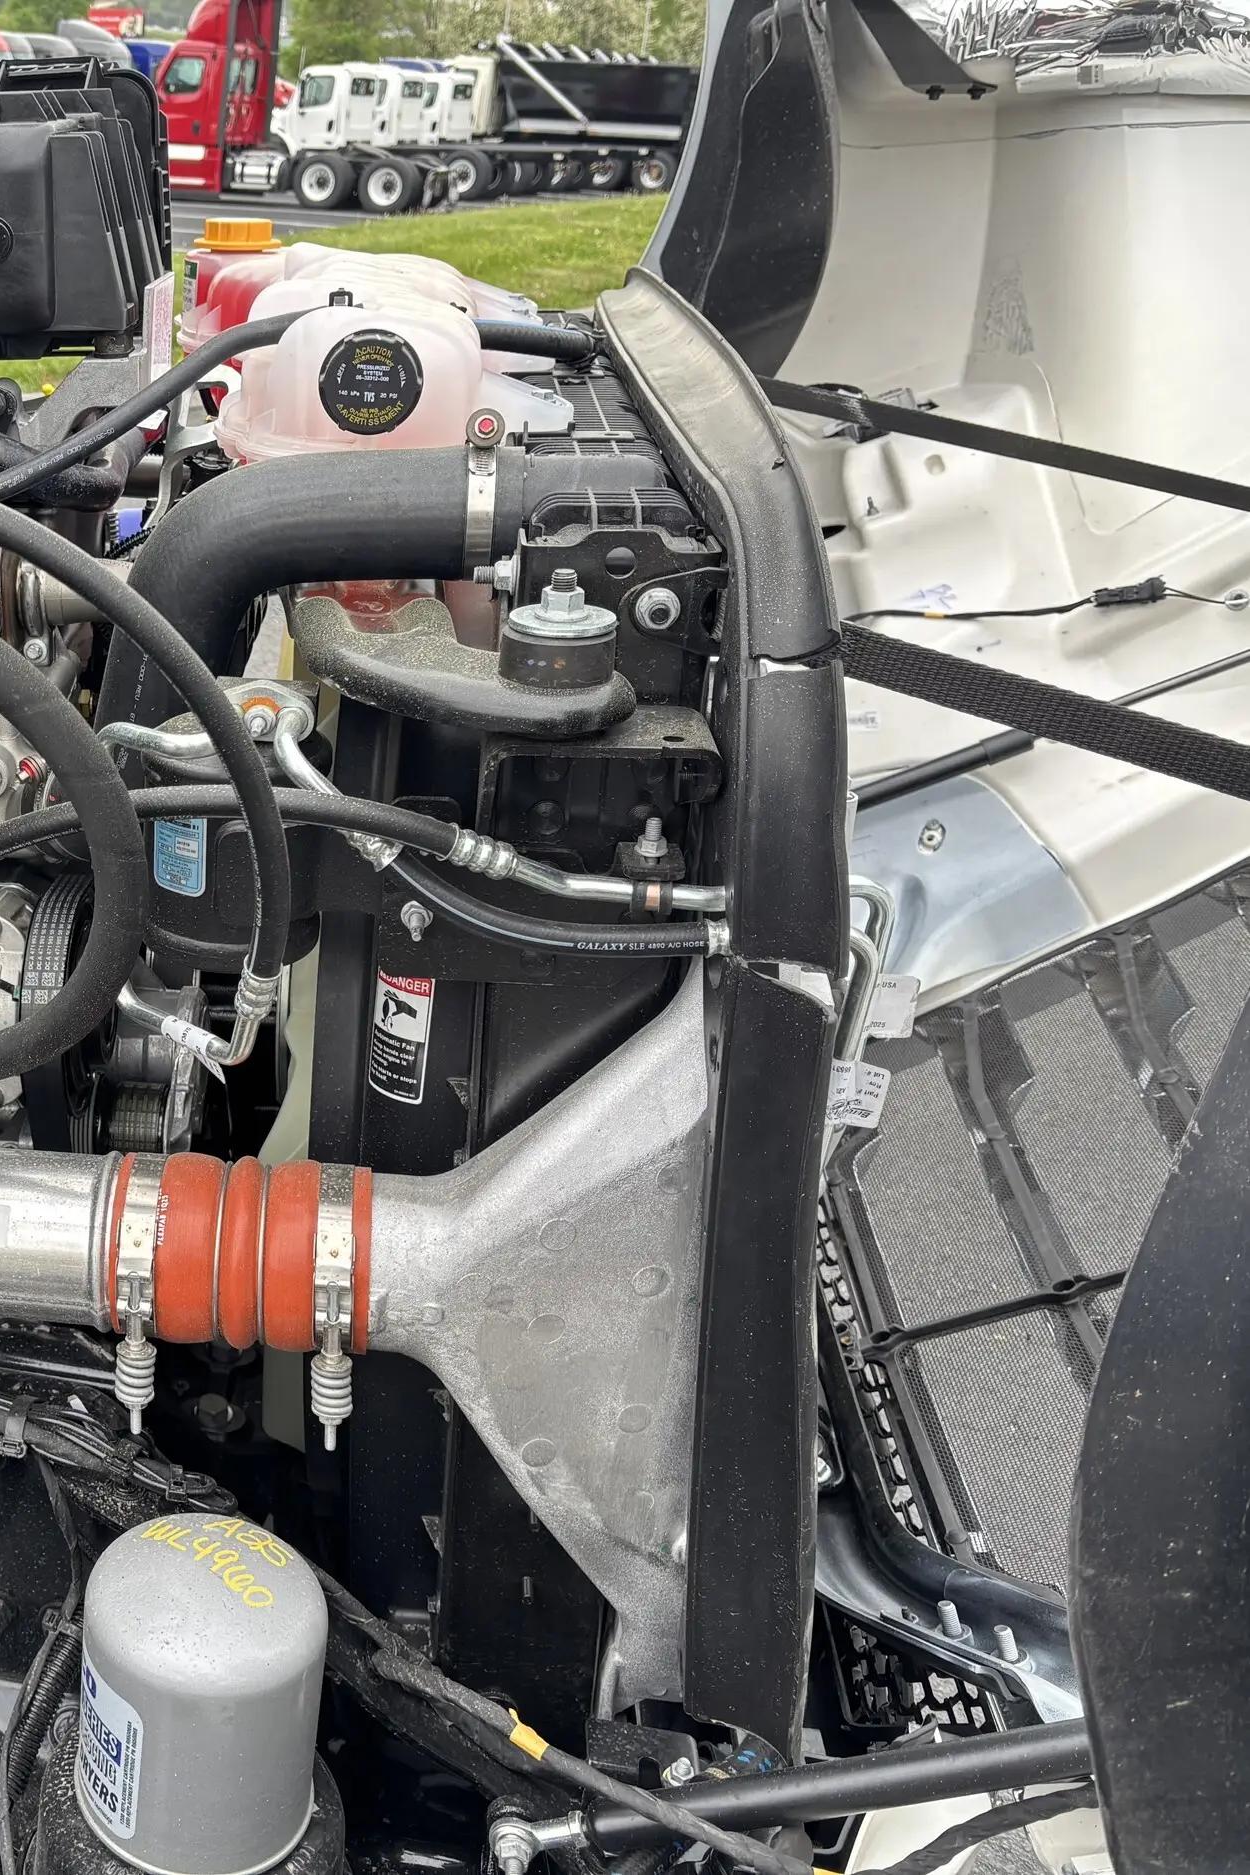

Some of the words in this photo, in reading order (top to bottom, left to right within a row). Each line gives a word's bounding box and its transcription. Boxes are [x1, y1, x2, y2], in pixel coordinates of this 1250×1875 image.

[362, 346, 393, 358] CAUTION
[364, 391, 375, 402] TVS
[340, 400, 404, 426] AVERTISSEMENT
[577, 942, 626, 950] GALAXY
[629, 942, 645, 950] SLE
[683, 940, 705, 948] HOSE
[882, 981, 897, 989] USA
[402, 1043, 416, 1051] Fan
